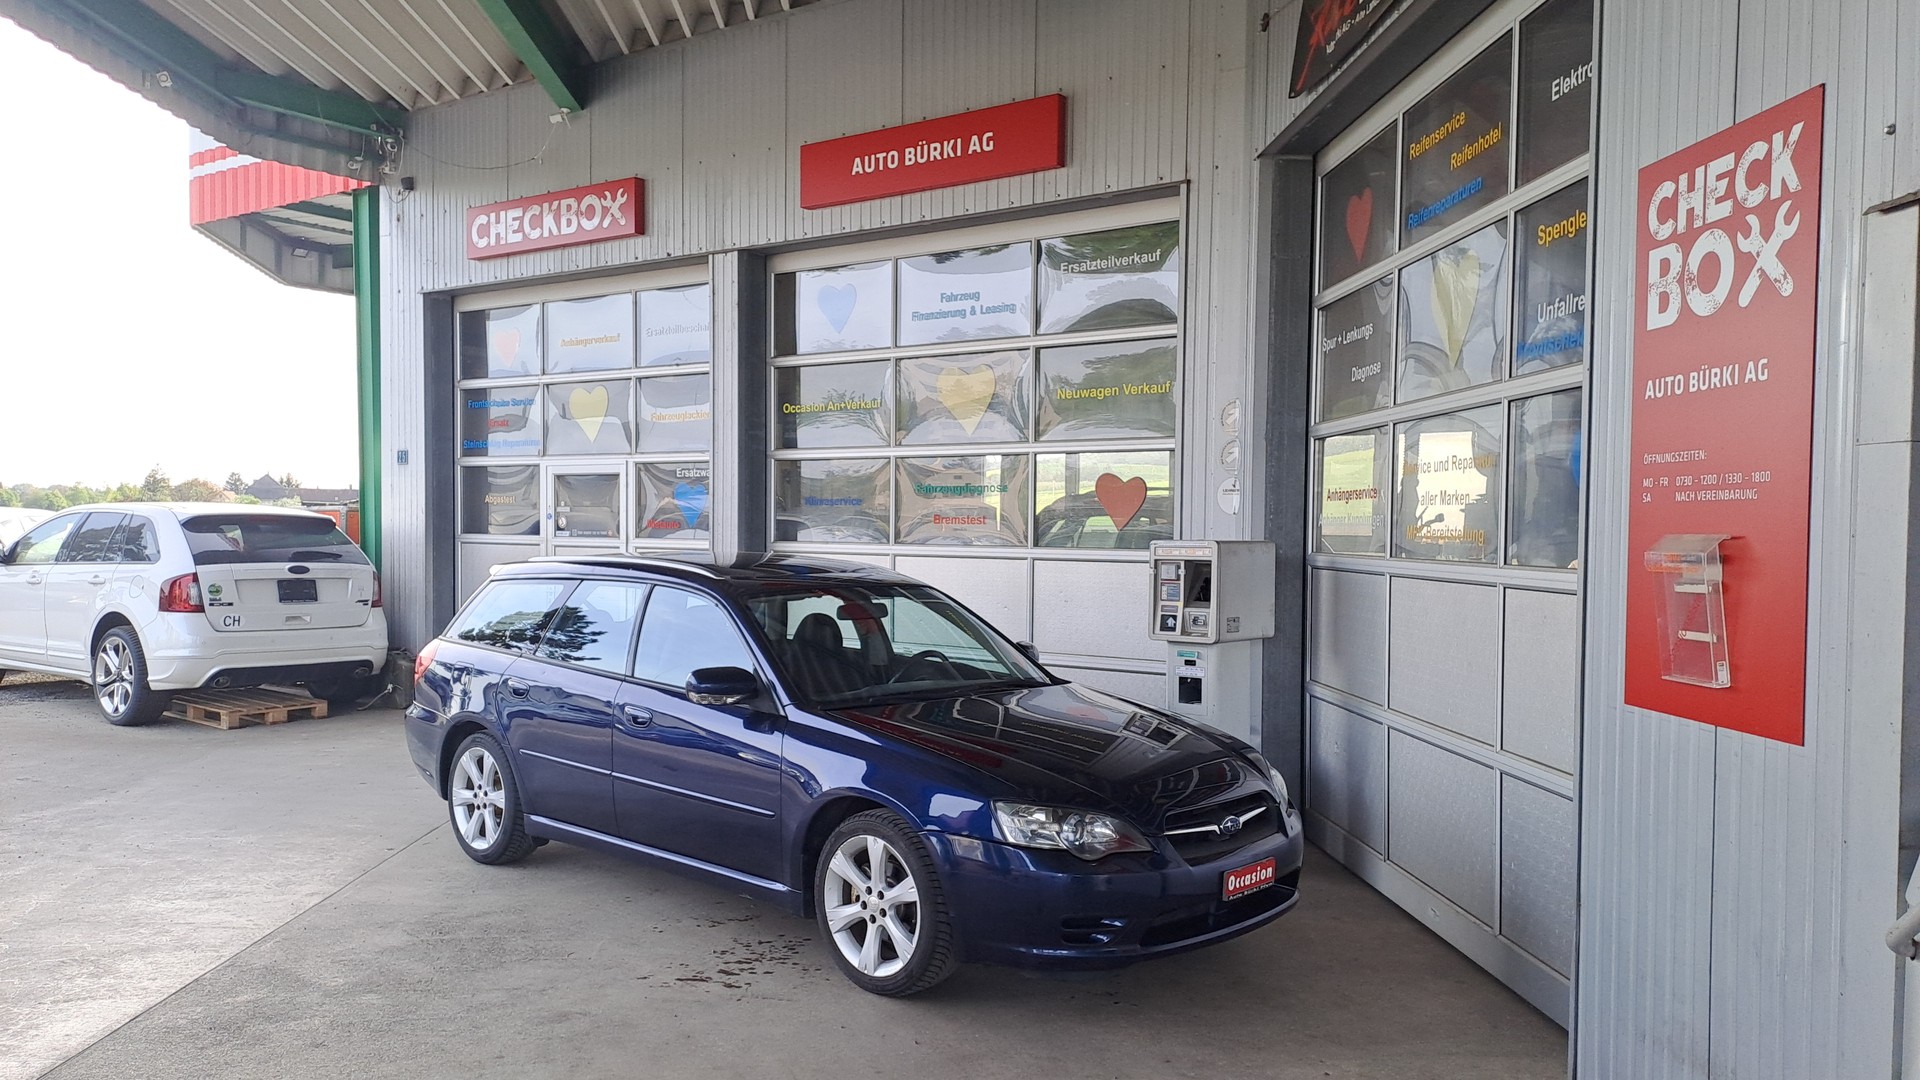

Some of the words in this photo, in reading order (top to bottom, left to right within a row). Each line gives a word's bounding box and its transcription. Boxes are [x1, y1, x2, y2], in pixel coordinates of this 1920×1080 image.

[1409, 111, 1466, 160] Reifenservice
[1450, 122, 1502, 171] Reifenhotel
[851, 150, 899, 176] AUTO
[904, 140, 962, 166] BÜRKI
[967, 131, 994, 155] AG
[1648, 120, 1805, 241] CHECK
[1408, 175, 1483, 230] Reifenreparaturen
[471, 187, 628, 249] CHECKBOX
[1537, 209, 1587, 247] Spengle
[1060, 249, 1162, 275] Ersatzteilverkauf
[1647, 200, 1801, 331] BOX
[940, 291, 980, 303] Fahrzeug
[1537, 293, 1585, 323] Unfallre
[911, 308, 967, 322] Finanzierung
[969, 305, 977, 316] &
[980, 302, 1017, 315] Leasing
[1321, 336, 1337, 354] Spur
[1337, 333, 1342, 345] +
[1342, 321, 1374, 346] Lenkungs
[1351, 360, 1382, 383] Diagnose
[1644, 374, 1685, 400] AUTO
[1689, 364, 1740, 393] BÜRKI
[1744, 358, 1769, 384] AG
[1056, 384, 1119, 400] Neuwagen
[1122, 380, 1171, 395] Verkauf
[782, 401, 826, 414] Occasion
[827, 398, 882, 413] An+Verkauf
[1434, 456, 1449, 473] und
[1643, 449, 1707, 465] ÖFFNUNGSZEITEN:
[1642, 478, 1653, 487] MO
[1659, 477, 1669, 487] FR
[1675, 476, 1693, 486] 0730
[1700, 474, 1717, 485] 1200
[1725, 473, 1742, 483] 1330
[1751, 471, 1771, 482] 1800
[484, 494, 516, 506] Abgastest
[1327, 485, 1378, 505] Anhängerservice
[1420, 491, 1438, 506] aller
[1440, 489, 1471, 506] Marken
[1642, 492, 1652, 503] SA
[1675, 491, 1695, 502] NACH
[1696, 488, 1758, 501] VEREINBARUNG
[933, 514, 987, 525] Bremstest
[223, 615, 241, 627] CH
[1228, 866, 1273, 891] Occasion
